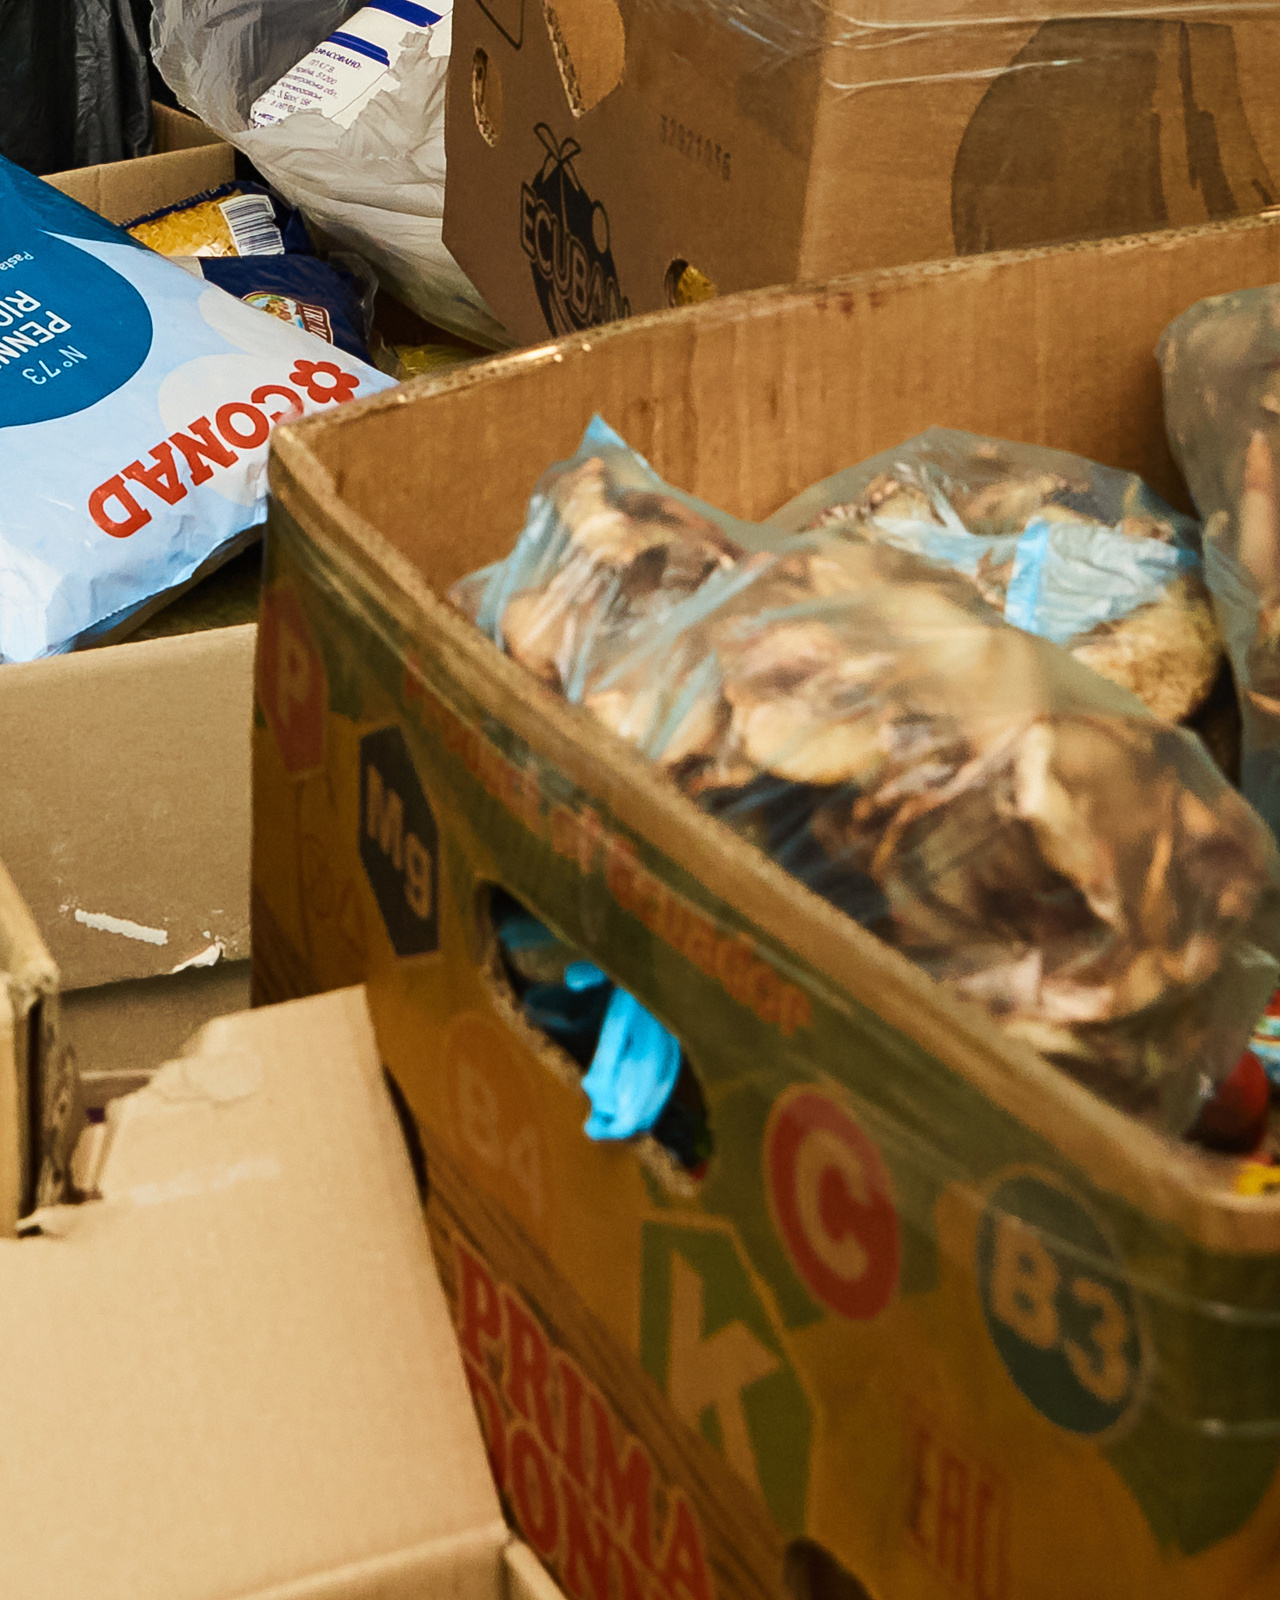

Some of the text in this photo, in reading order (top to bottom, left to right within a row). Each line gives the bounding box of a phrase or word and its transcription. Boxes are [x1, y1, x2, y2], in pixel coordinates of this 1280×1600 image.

[22, 359, 62, 385] 73
[87, 384, 305, 539] CONAD
[365, 762, 432, 922] Mg
[990, 1213, 1131, 1405] B3
